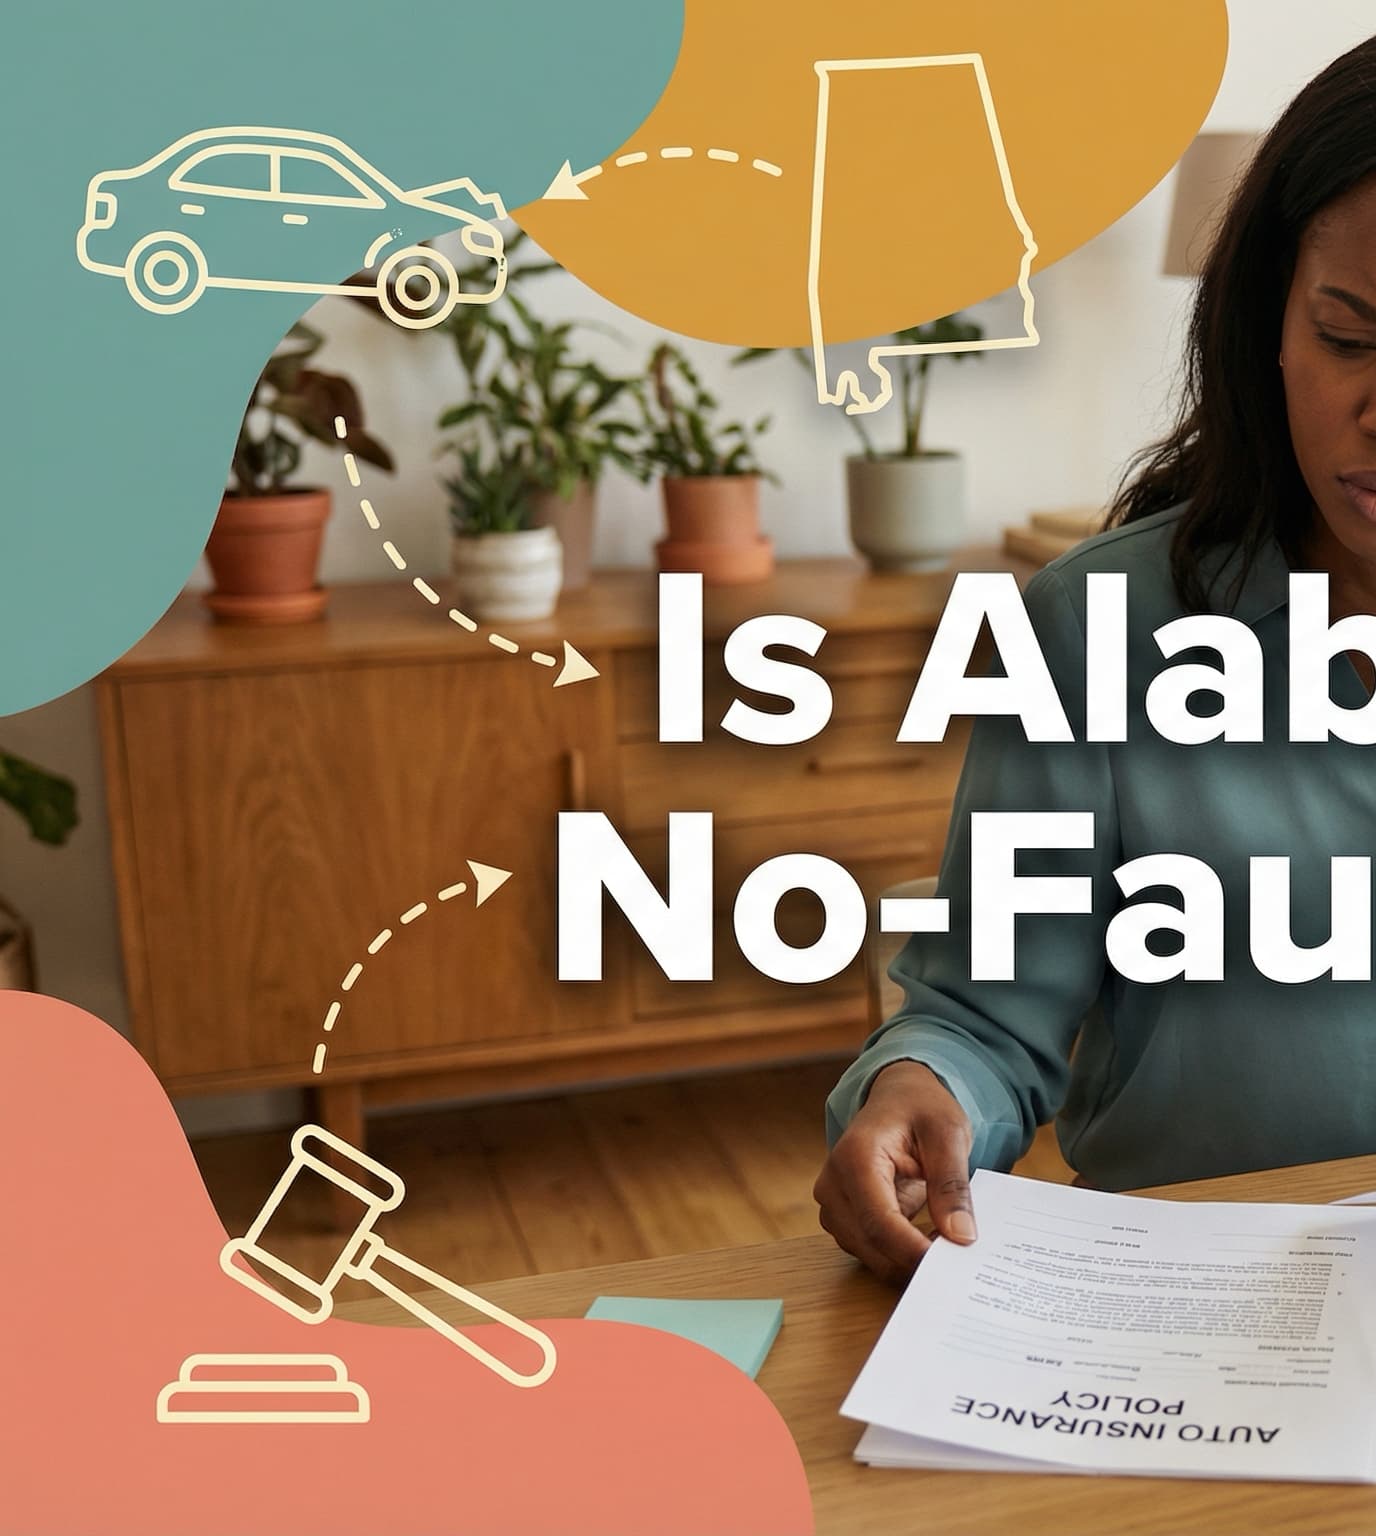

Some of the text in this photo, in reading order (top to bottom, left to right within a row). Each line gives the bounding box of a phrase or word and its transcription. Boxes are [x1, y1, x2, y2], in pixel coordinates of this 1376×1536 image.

[950, 1394, 1280, 1446] AUTO INSURANCE
[1048, 1389, 1187, 1418] POLICY
